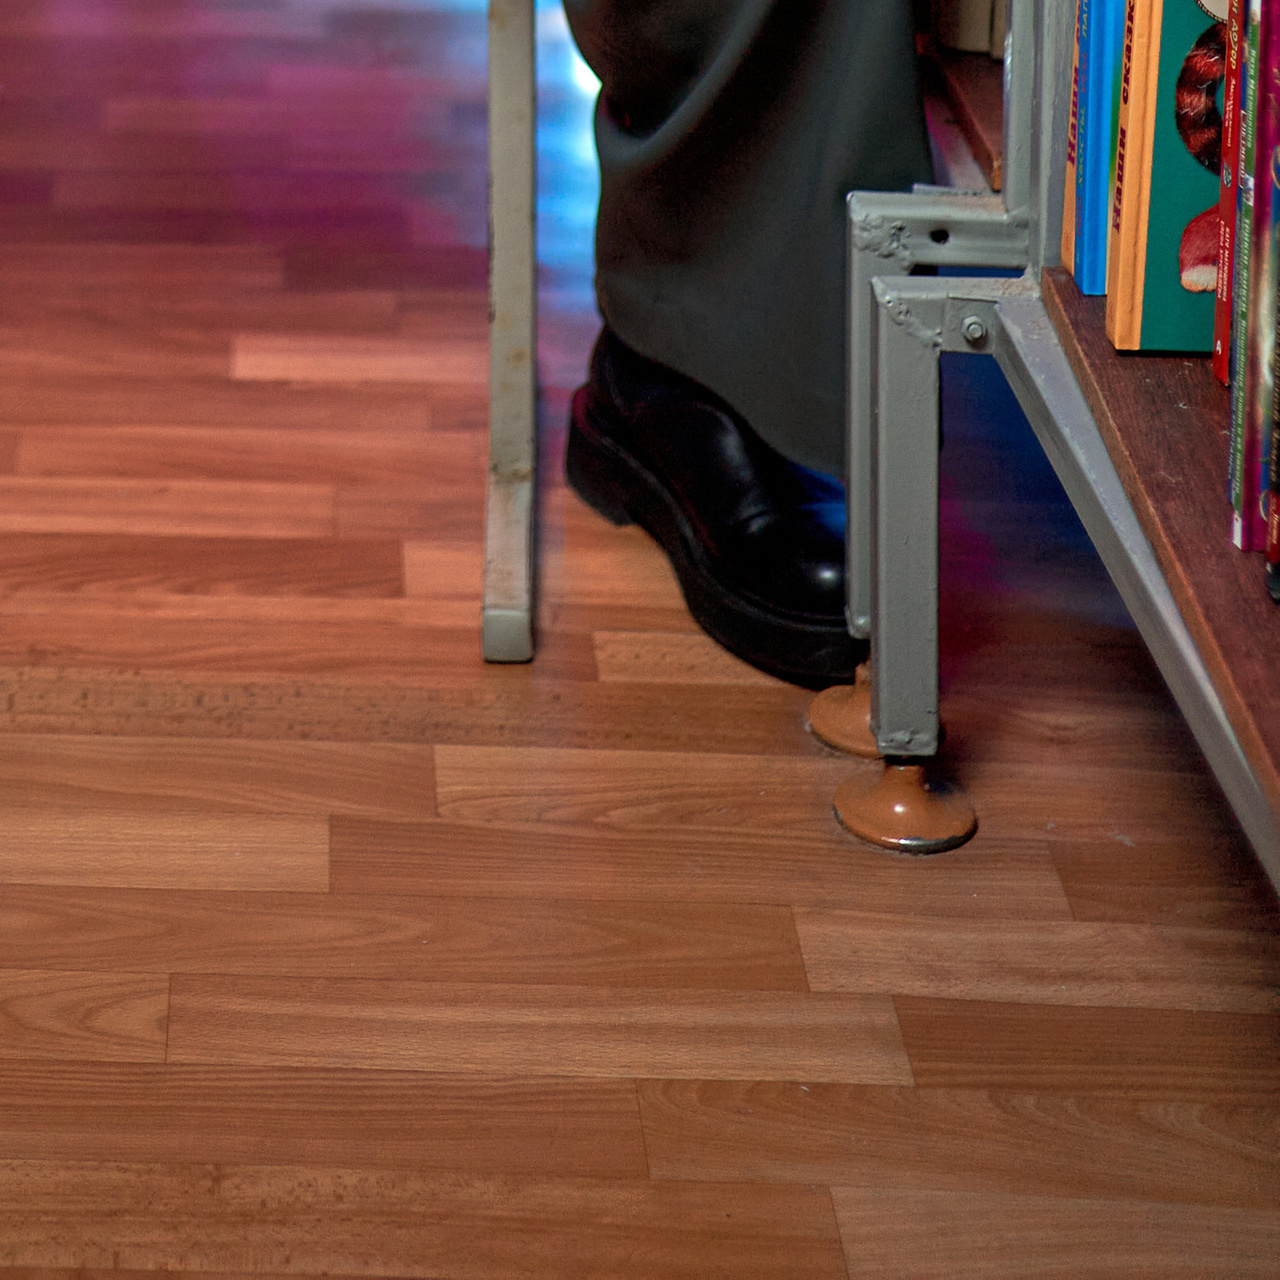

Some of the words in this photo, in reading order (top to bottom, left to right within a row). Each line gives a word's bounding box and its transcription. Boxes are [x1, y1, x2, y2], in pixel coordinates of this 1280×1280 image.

[1229, 19, 1238, 71] ДОЗОР
[1066, 63, 1080, 167] Наши
[1112, 124, 1126, 233] Наши
